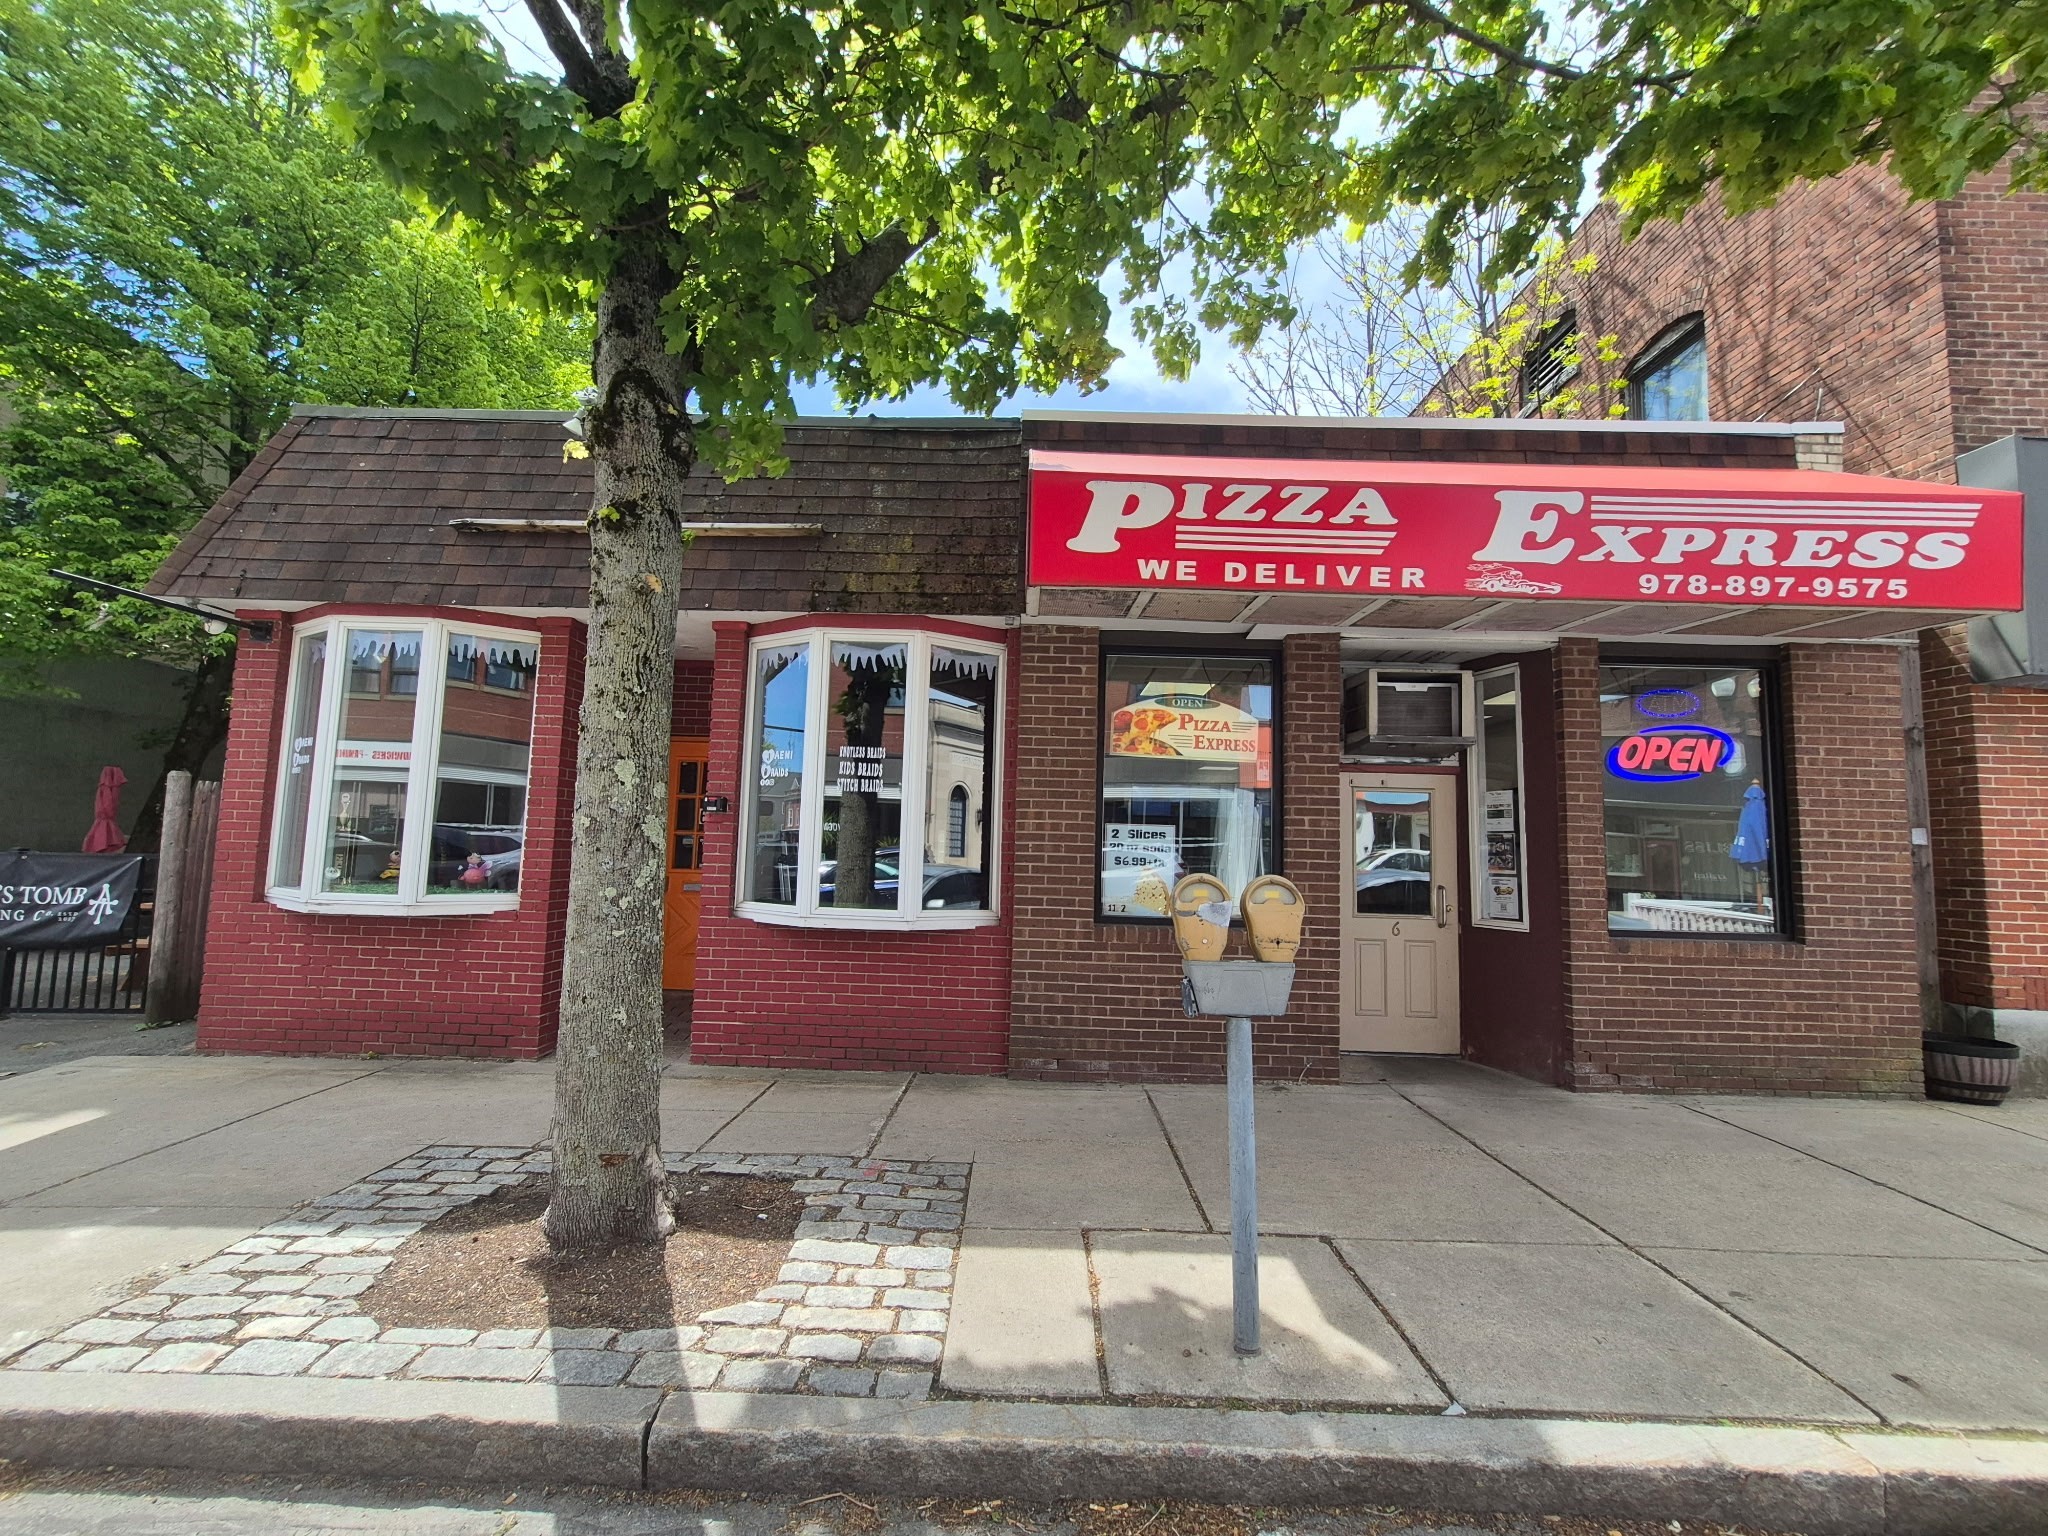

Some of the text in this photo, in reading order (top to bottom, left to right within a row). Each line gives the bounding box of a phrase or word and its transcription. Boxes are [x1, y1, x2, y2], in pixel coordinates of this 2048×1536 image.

[1066, 480, 1971, 570] PIZZA EXPRESS
[1137, 558, 1426, 588] WE DELIVER
[1638, 573, 1909, 599] 978-897-9575
[1172, 698, 1204, 708] OPEN
[1178, 713, 1232, 732] PIZZA
[839, 746, 886, 759] KNOTLESS BRAIDS
[1193, 735, 1256, 753] EXPRESS
[1617, 736, 1722, 772] OPEN
[839, 761, 883, 777] KIDS BRAIDS
[837, 778, 884, 792] STITCH BRAIDS
[1111, 828, 1167, 840] 2 Slices
[20, 886, 88, 905] TOMB
[1391, 921, 1400, 937] 6
